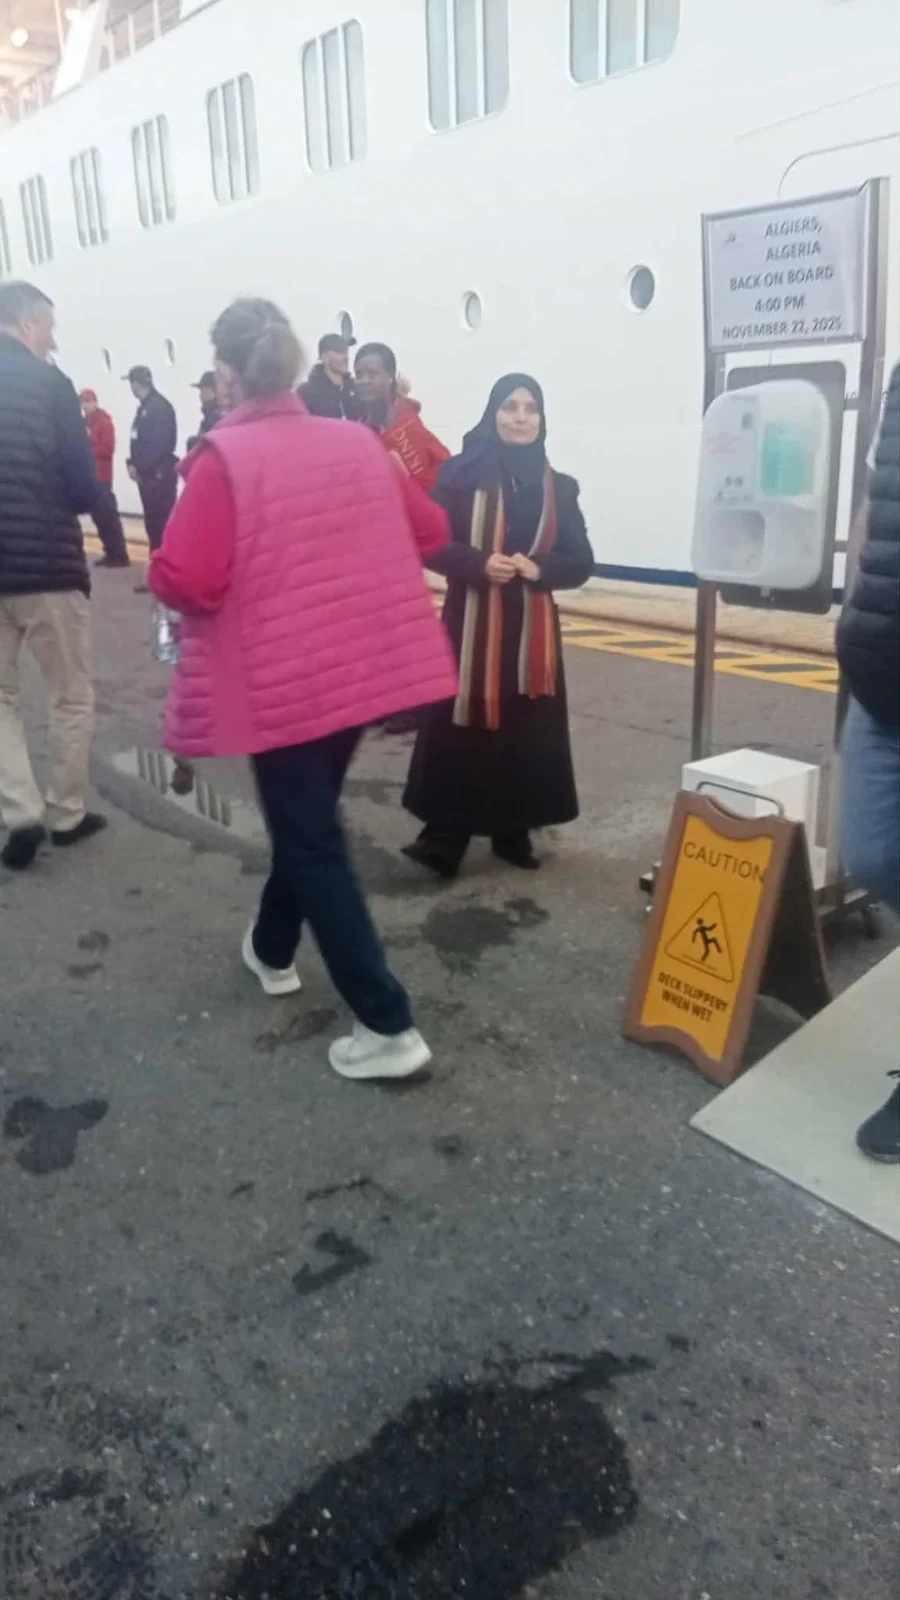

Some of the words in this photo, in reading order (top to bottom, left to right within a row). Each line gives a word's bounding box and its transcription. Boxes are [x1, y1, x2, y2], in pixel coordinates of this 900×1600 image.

[765, 216, 822, 239] ALGIERS,
[766, 240, 821, 262] ALGERIA
[729, 273, 762, 292] BACK
[763, 271, 783, 288] ON
[787, 264, 835, 285] BOARD
[755, 297, 781, 312] 4:00
[784, 293, 805, 311] PM
[722, 320, 788, 339] NOVEMBER
[791, 318, 809, 335] 22,
[812, 314, 842, 332] 2025
[683, 841, 764, 884] CAUTION
[658, 971, 682, 990] DECK
[682, 983, 729, 1012] SLIPPERY
[661, 988, 690, 1013] WHEN
[690, 1003, 714, 1022] WET
